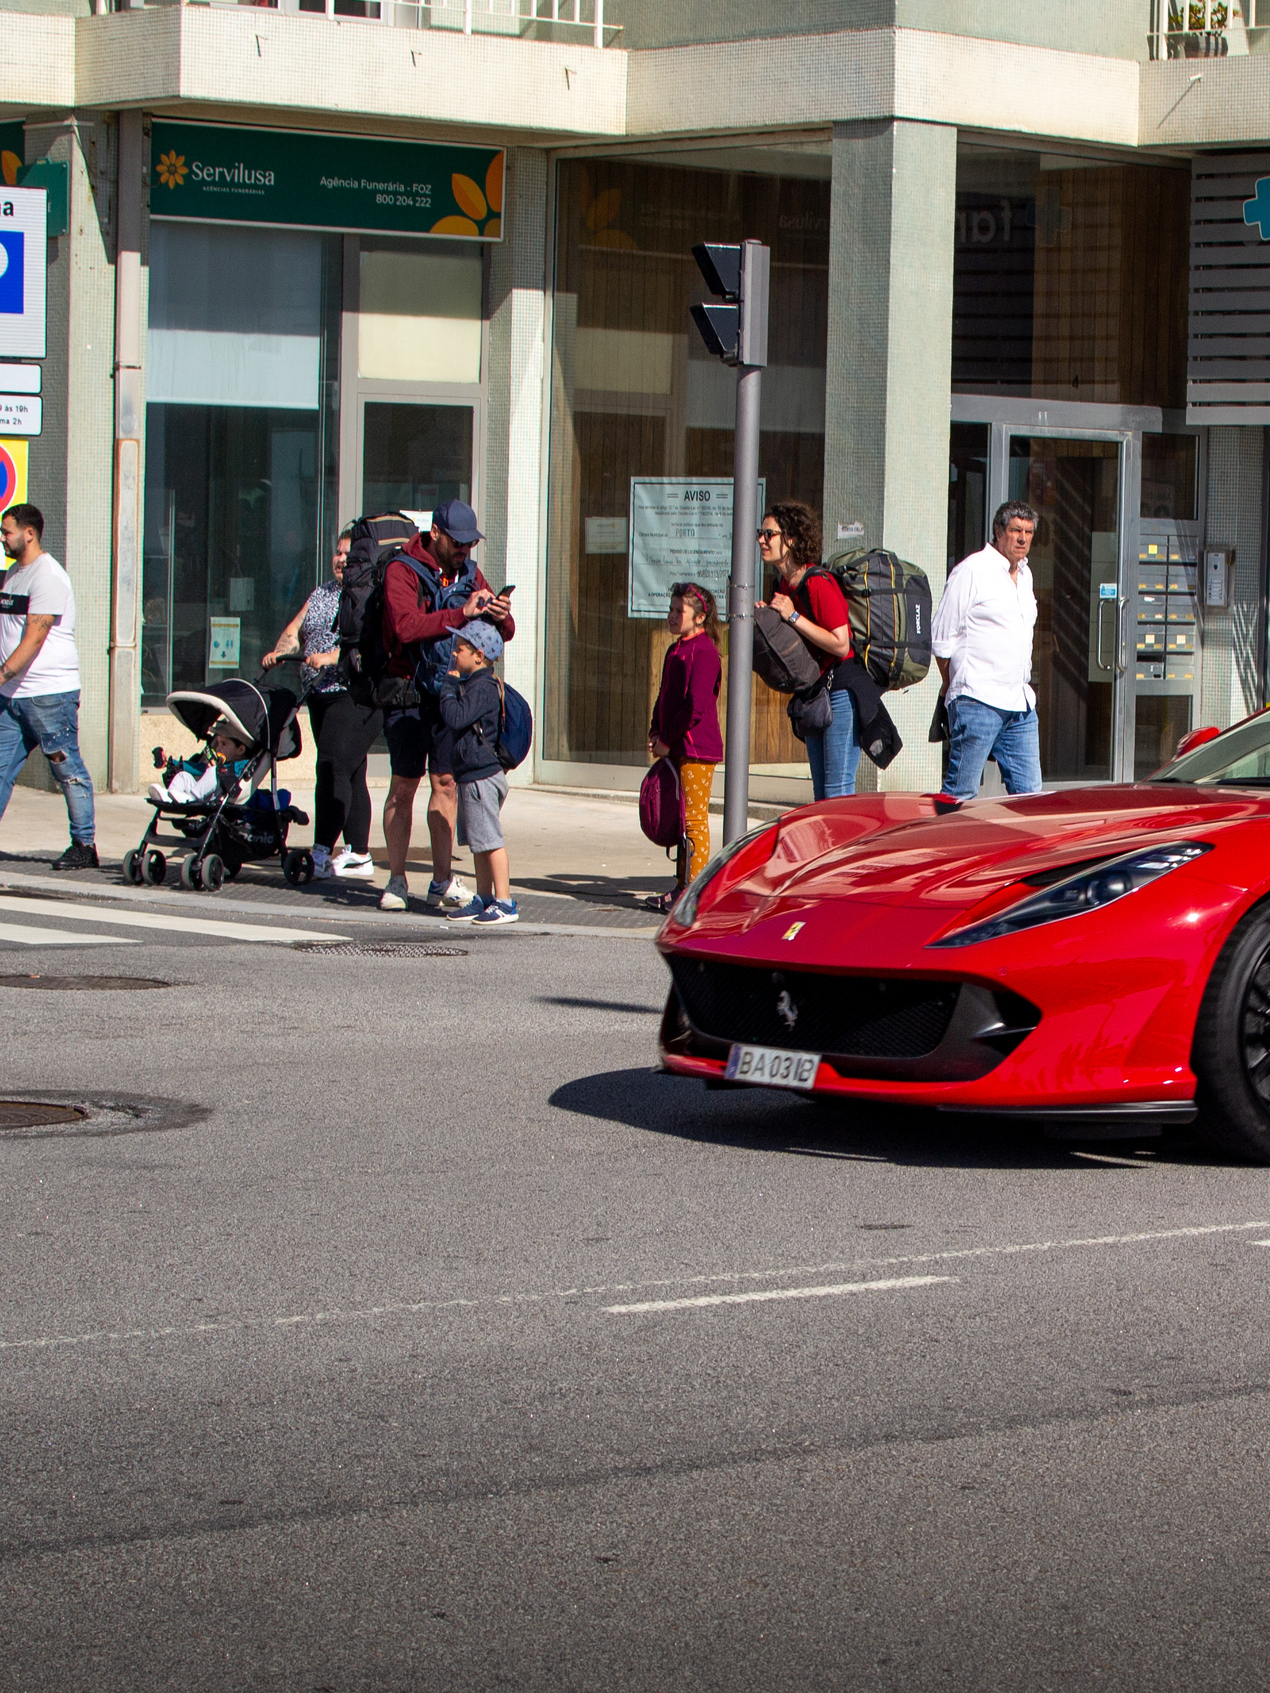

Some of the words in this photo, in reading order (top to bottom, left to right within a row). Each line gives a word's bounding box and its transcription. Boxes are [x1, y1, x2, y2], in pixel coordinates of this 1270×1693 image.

[192, 161, 275, 185] Servilusa
[320, 176, 358, 188] Agência
[361, 179, 405, 192] Funerária
[413, 183, 432, 194] FOZ
[376, 193, 394, 204] 800
[396, 195, 413, 206] 204
[415, 197, 432, 207] 222
[16, 405, 28, 413] 19h
[13, 417, 22, 425] 2h
[684, 490, 711, 501] AVISO
